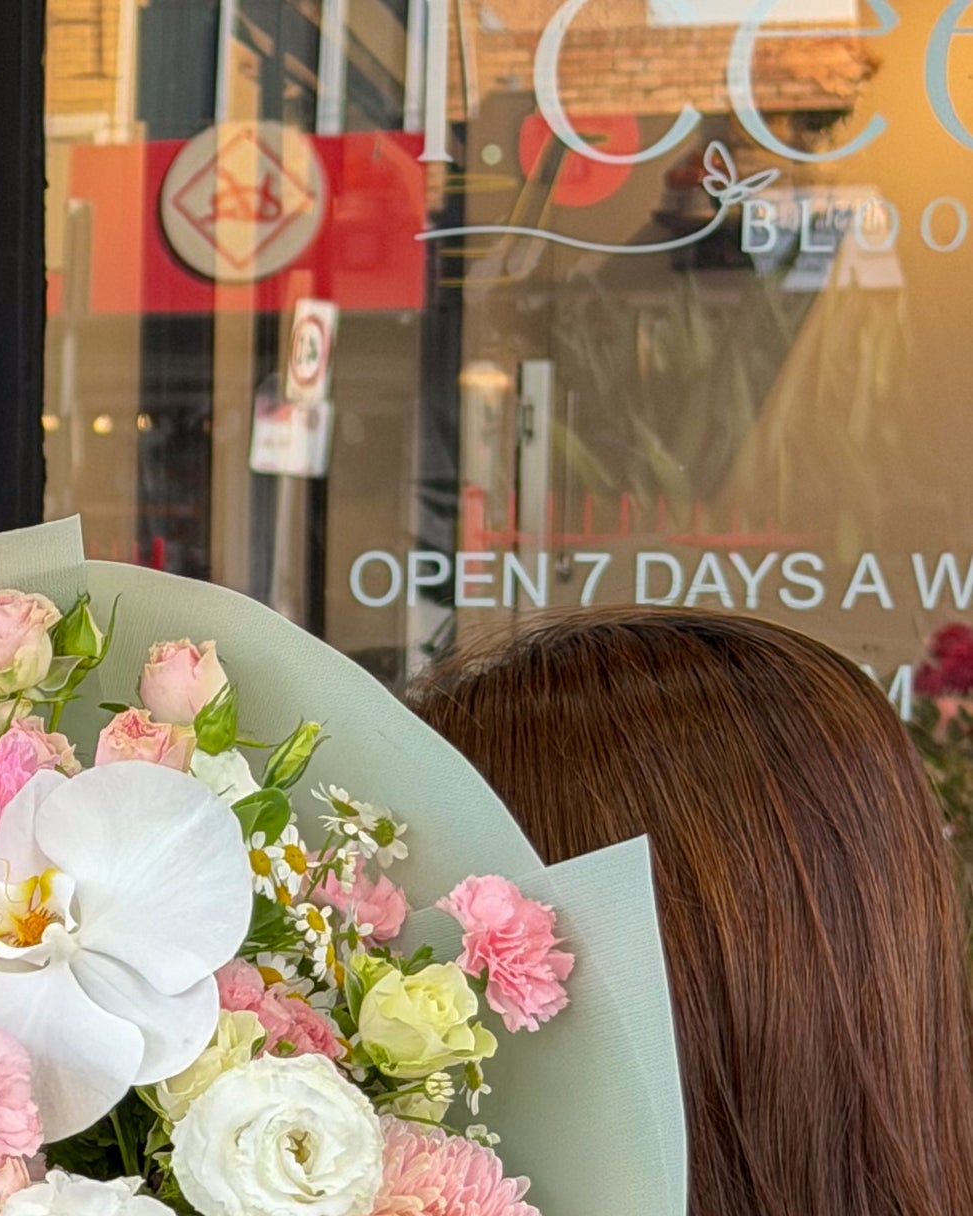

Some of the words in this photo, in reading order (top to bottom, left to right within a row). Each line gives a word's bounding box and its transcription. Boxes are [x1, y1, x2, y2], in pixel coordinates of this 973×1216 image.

[741, 197, 968, 252] BLOO
[349, 551, 548, 608] OPEN
[573, 553, 610, 607] 7
[636, 552, 825, 610] DAYS
[840, 553, 895, 610] A
